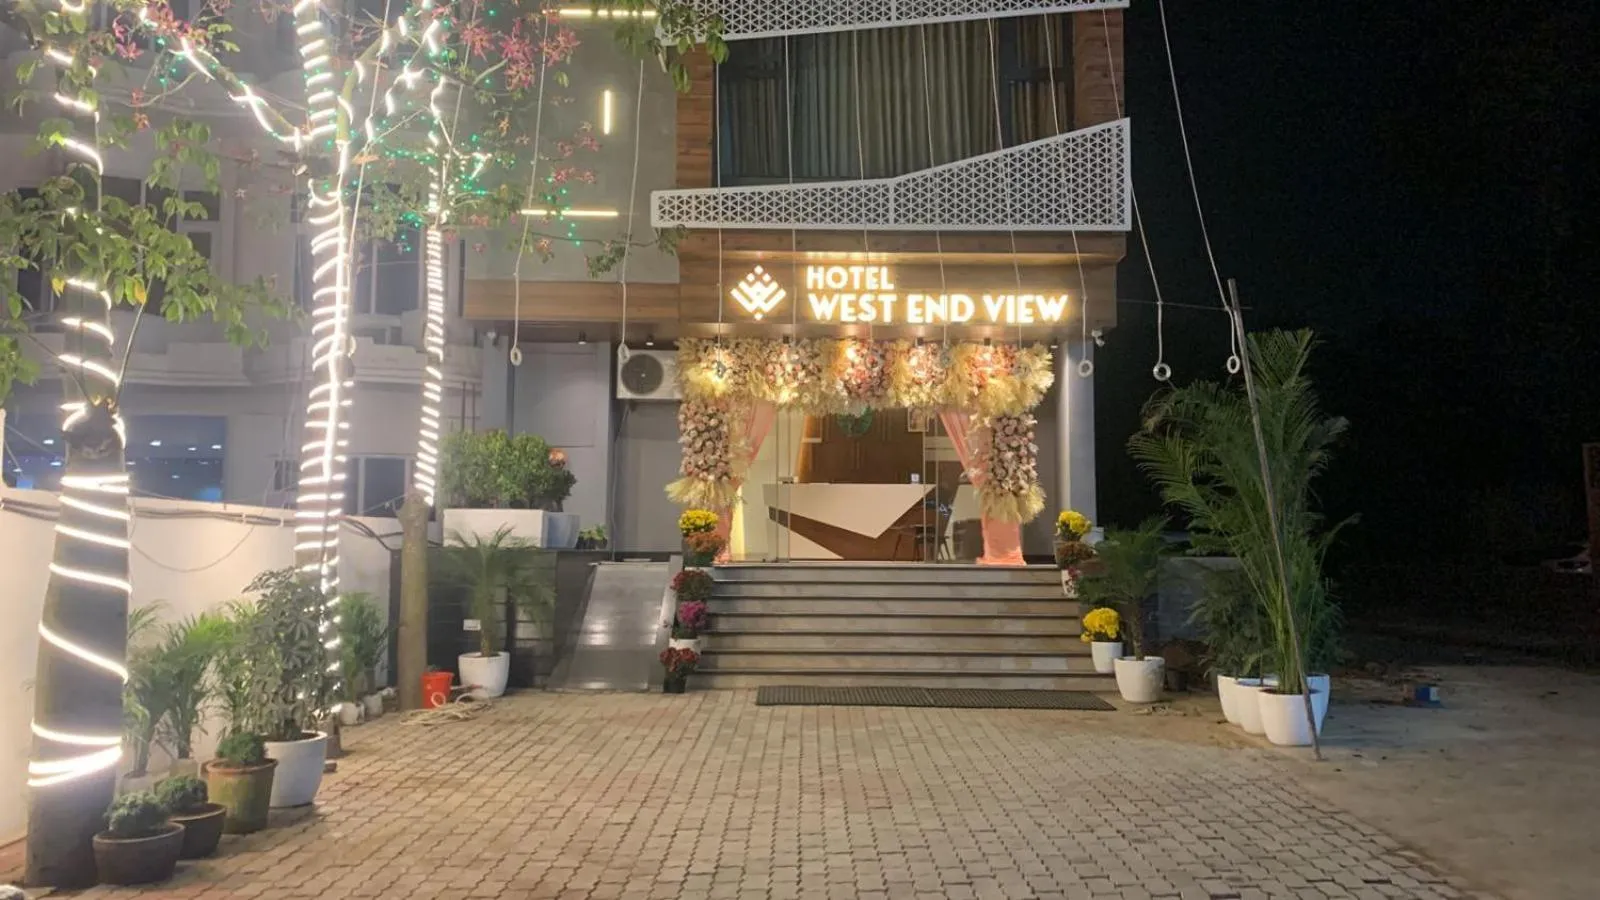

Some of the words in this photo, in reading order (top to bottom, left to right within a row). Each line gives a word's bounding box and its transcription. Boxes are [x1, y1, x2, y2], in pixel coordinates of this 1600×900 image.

[807, 266, 894, 290] HOTEL
[808, 294, 898, 322] WEST
[906, 294, 976, 323] END
[982, 294, 1068, 323] VIEW
